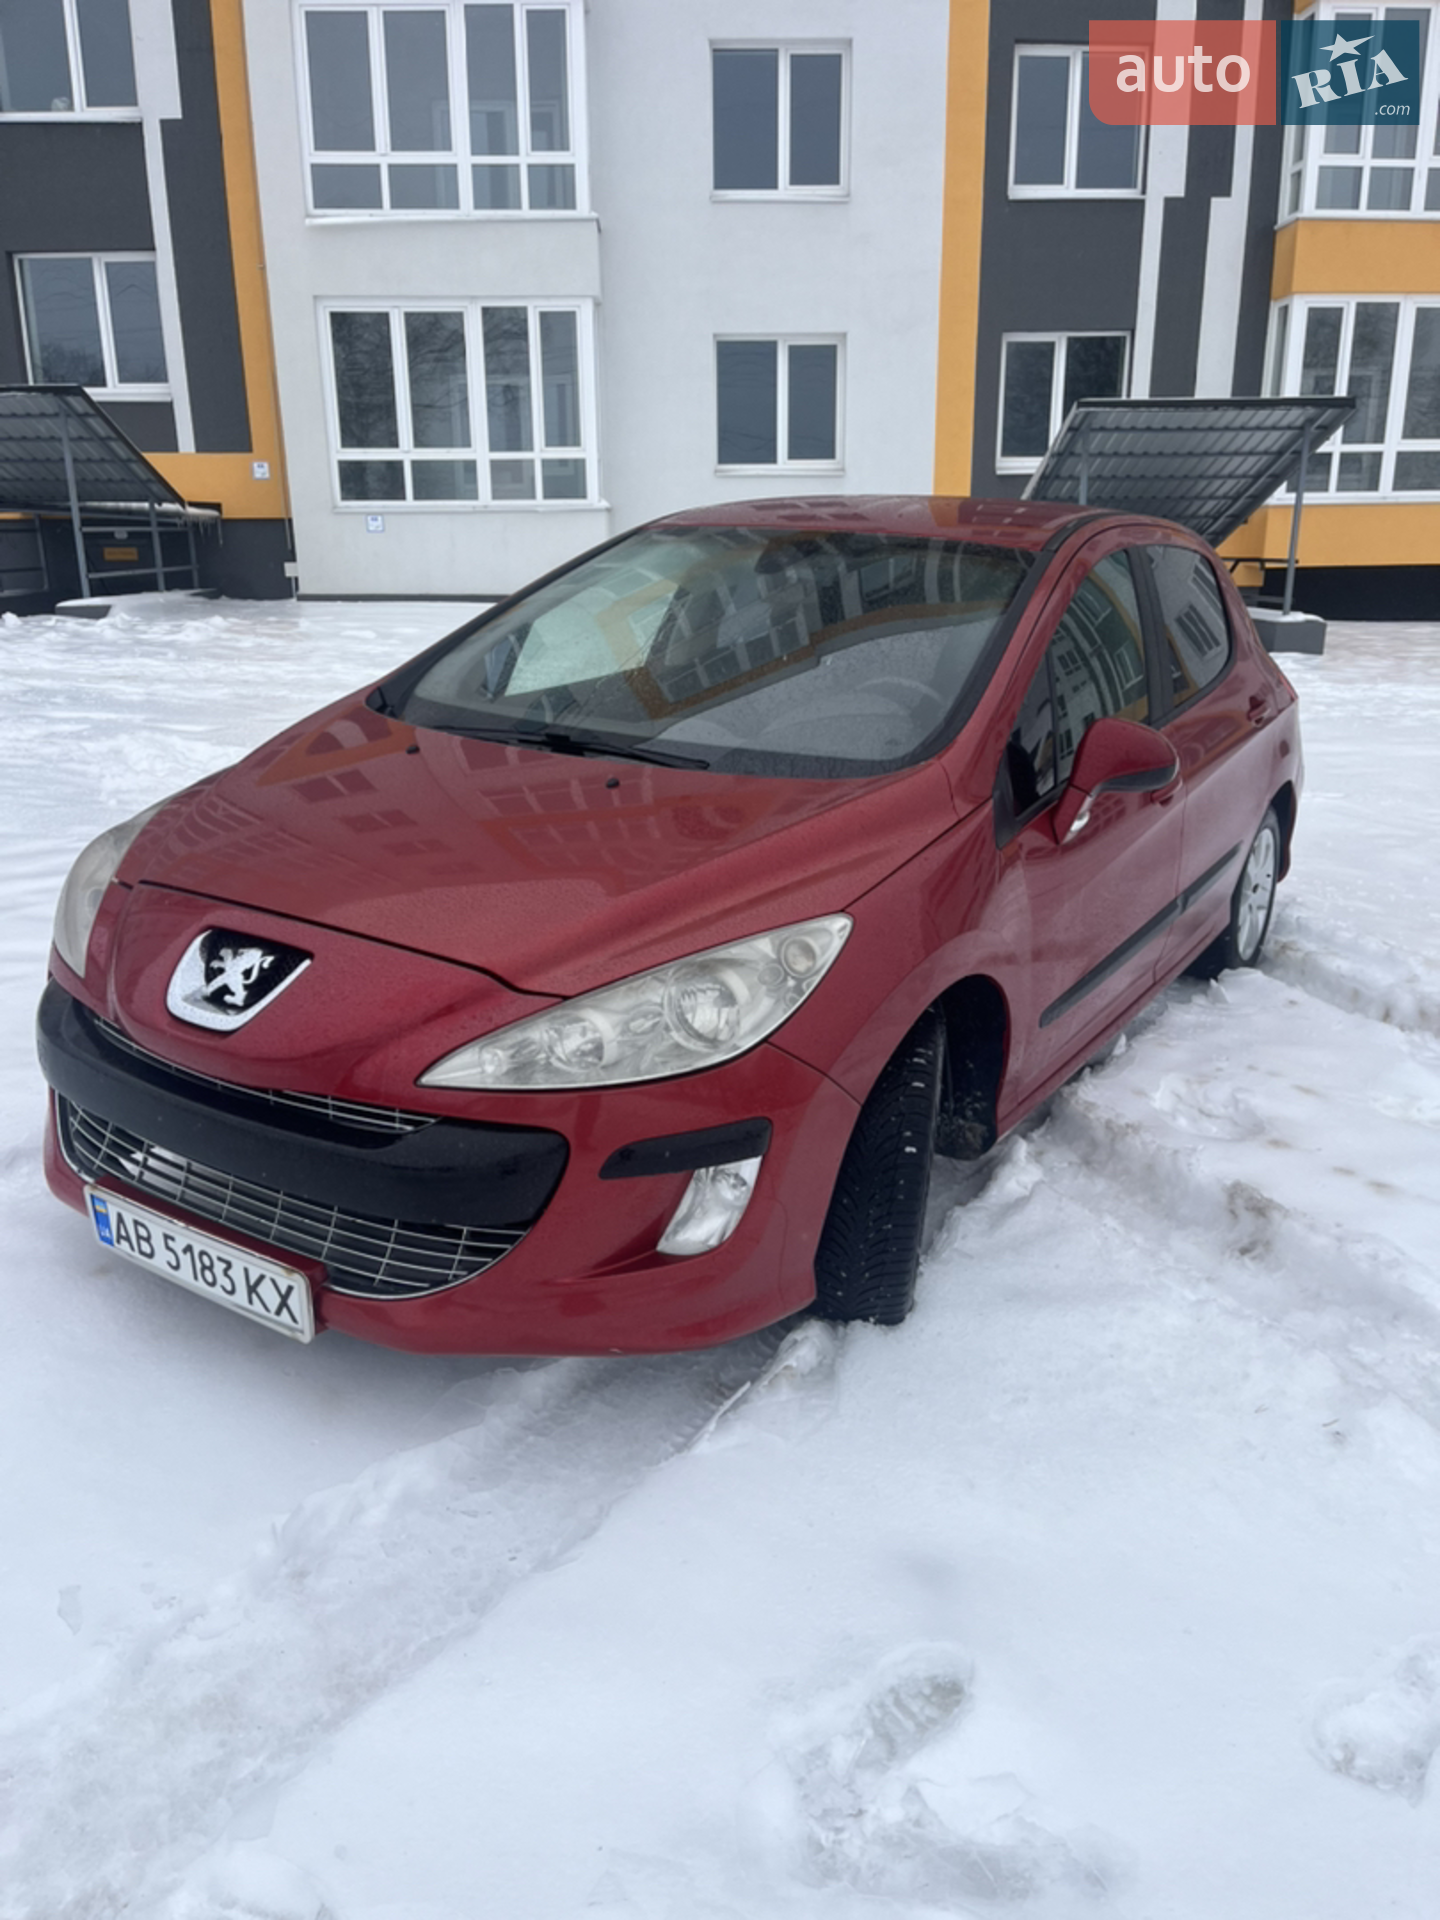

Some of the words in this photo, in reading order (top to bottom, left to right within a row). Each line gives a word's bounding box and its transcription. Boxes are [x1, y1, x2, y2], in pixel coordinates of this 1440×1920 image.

[115, 1211, 155, 1260] AB
[162, 1232, 237, 1297] 5183
[243, 1266, 299, 1325] KX
